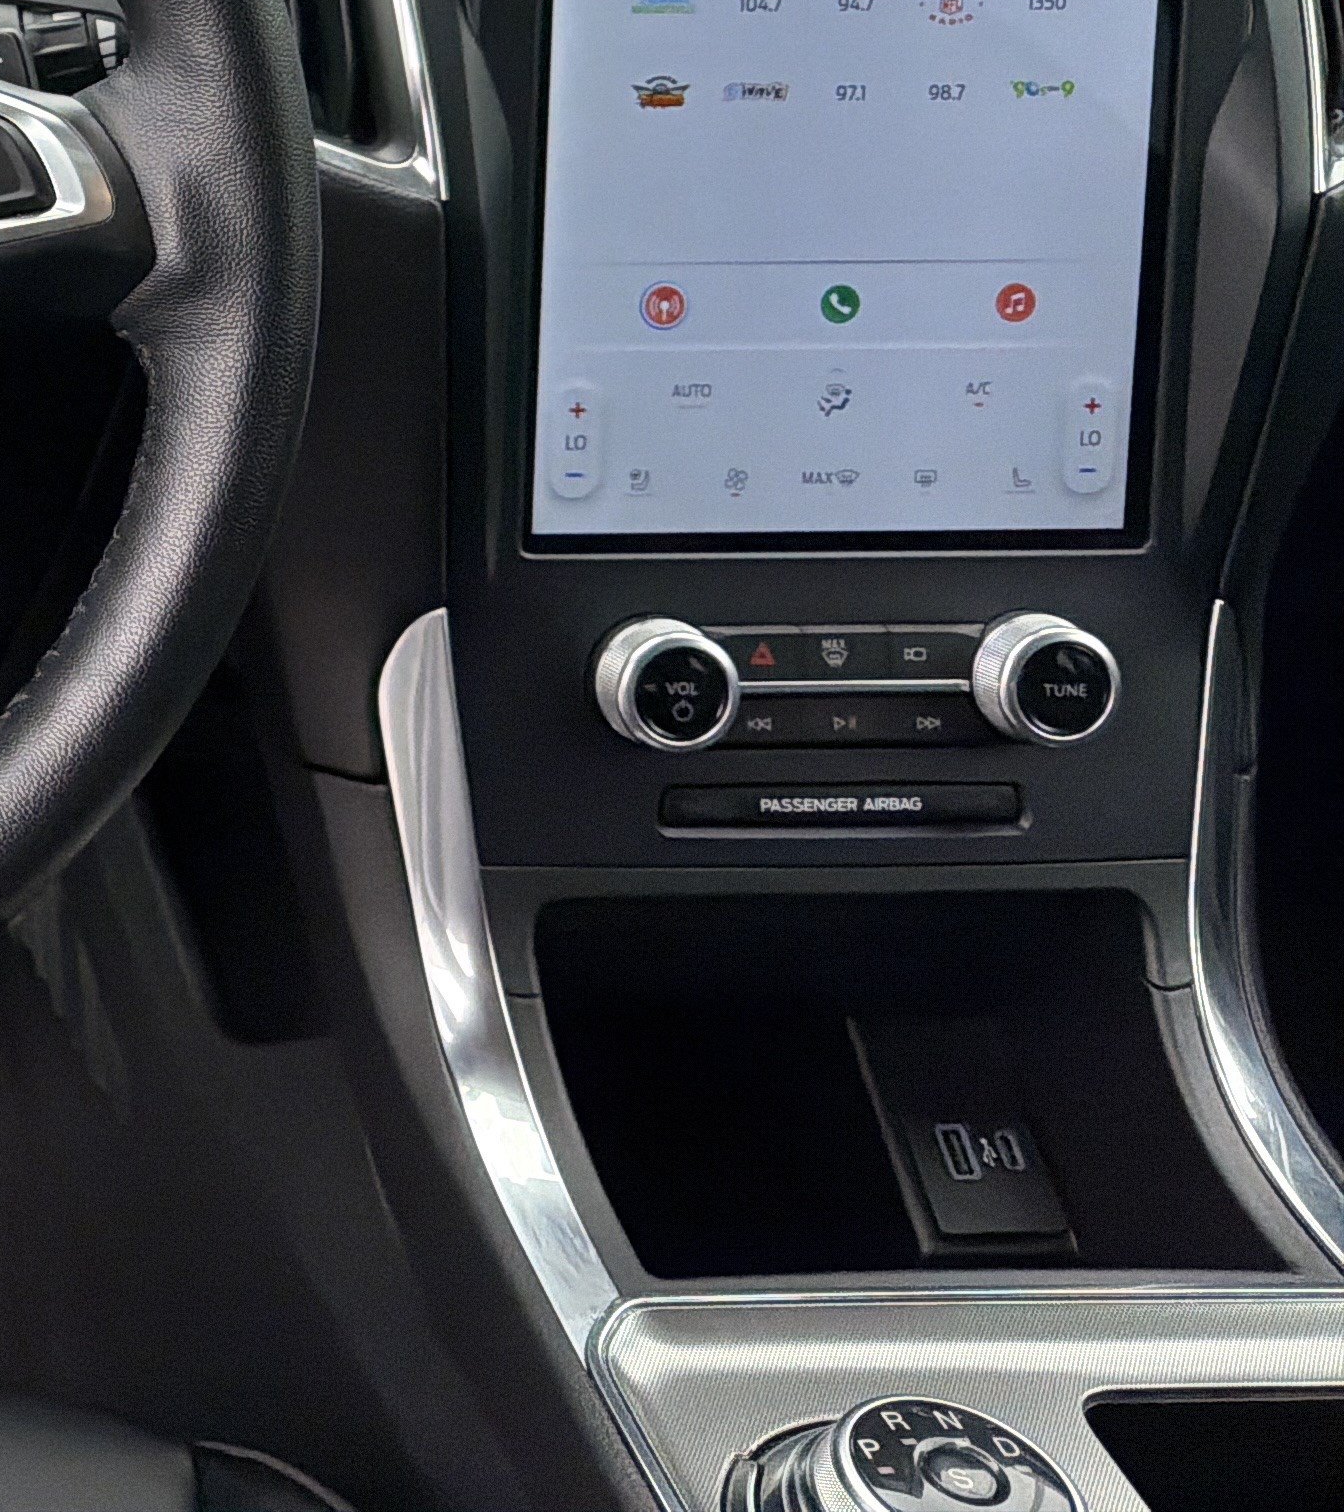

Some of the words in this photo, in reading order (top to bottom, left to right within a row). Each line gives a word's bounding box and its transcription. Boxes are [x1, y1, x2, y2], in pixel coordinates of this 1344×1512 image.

[836, 85, 866, 101] 97.1
[928, 84, 966, 101] 98.7
[672, 383, 712, 398] AUTO
[965, 381, 992, 395] A/C
[565, 434, 587, 451] LO
[1080, 429, 1102, 446] LO
[802, 472, 833, 484] MAX
[665, 681, 698, 697] VOL
[1043, 683, 1088, 699] TUNE
[760, 797, 857, 813] PASSENGER
[863, 797, 923, 813] AIRBAG
[857, 1439, 881, 1460] P
[880, 1411, 911, 1430] R
[933, 1410, 963, 1429] N
[993, 1437, 1020, 1457] D
[947, 1468, 973, 1488] S
